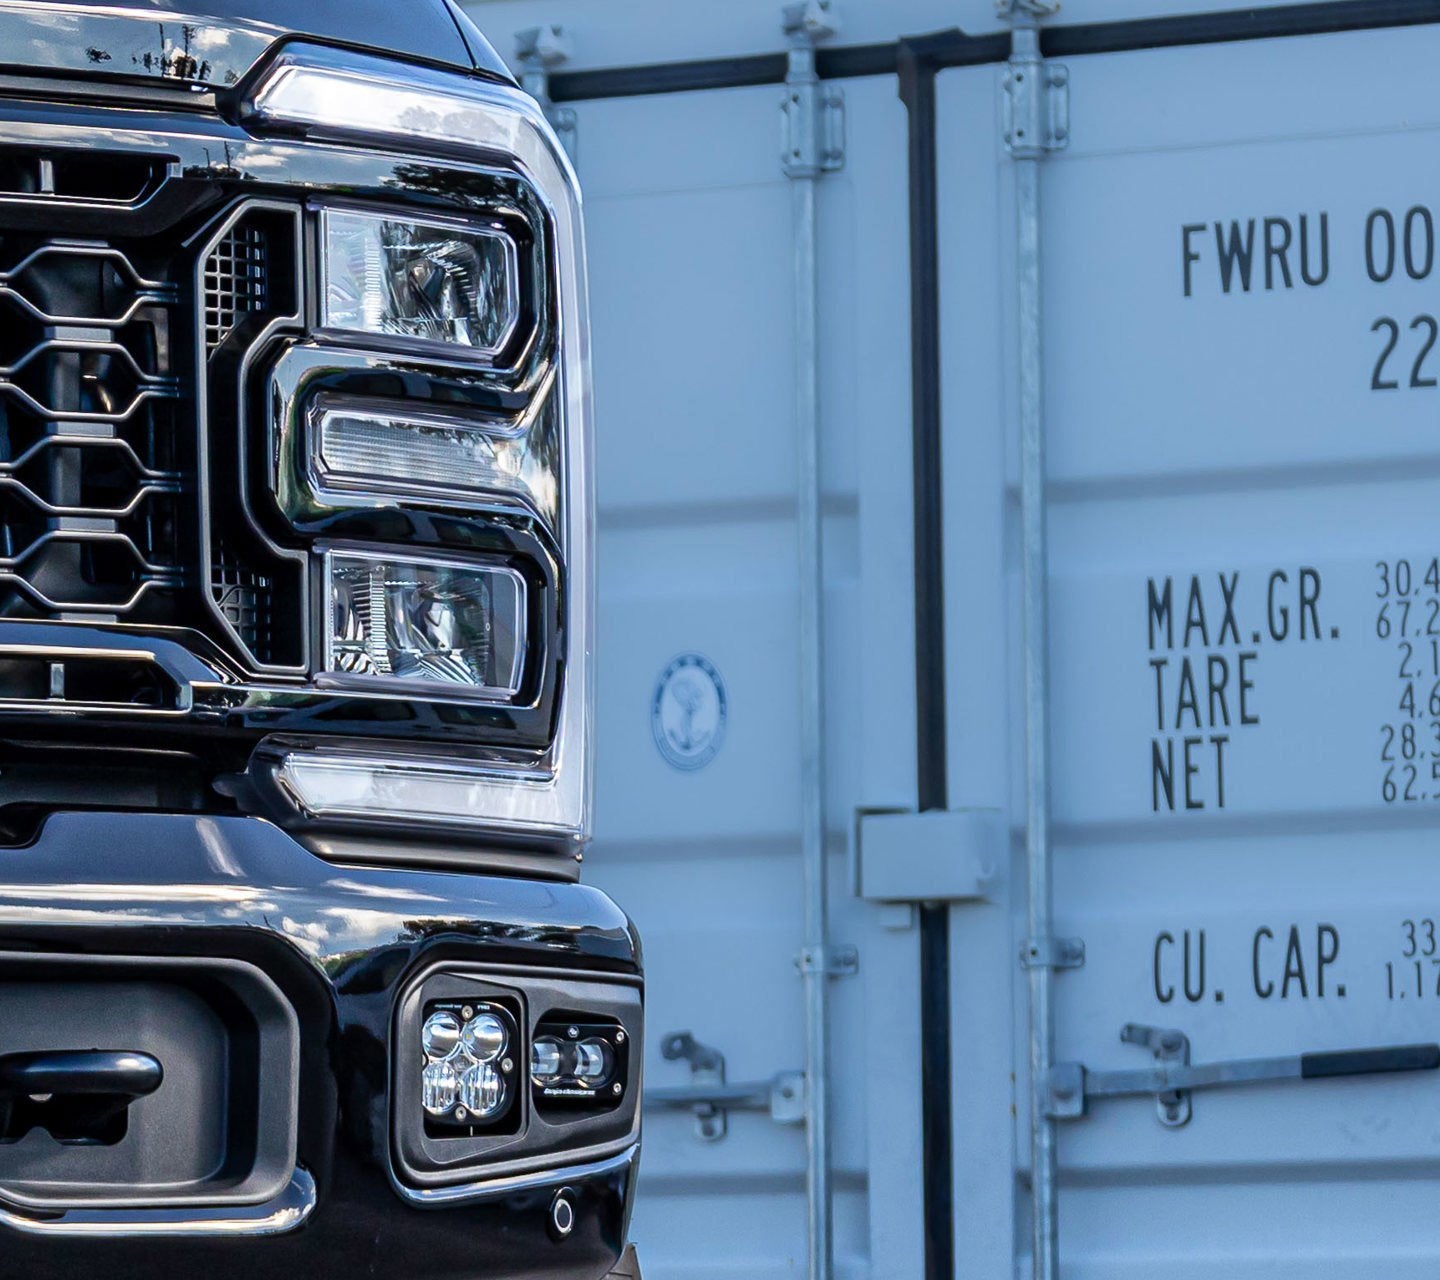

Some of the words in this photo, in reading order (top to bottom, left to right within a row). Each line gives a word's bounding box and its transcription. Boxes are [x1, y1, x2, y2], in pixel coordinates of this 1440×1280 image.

[1181, 211, 1330, 298] FWRU
[1146, 565, 1340, 651] MAX.GR.
[1149, 651, 1260, 731] TARE
[1151, 734, 1230, 812] NET
[1153, 928, 1225, 1003] CU.
[1252, 923, 1347, 999] CAP.
